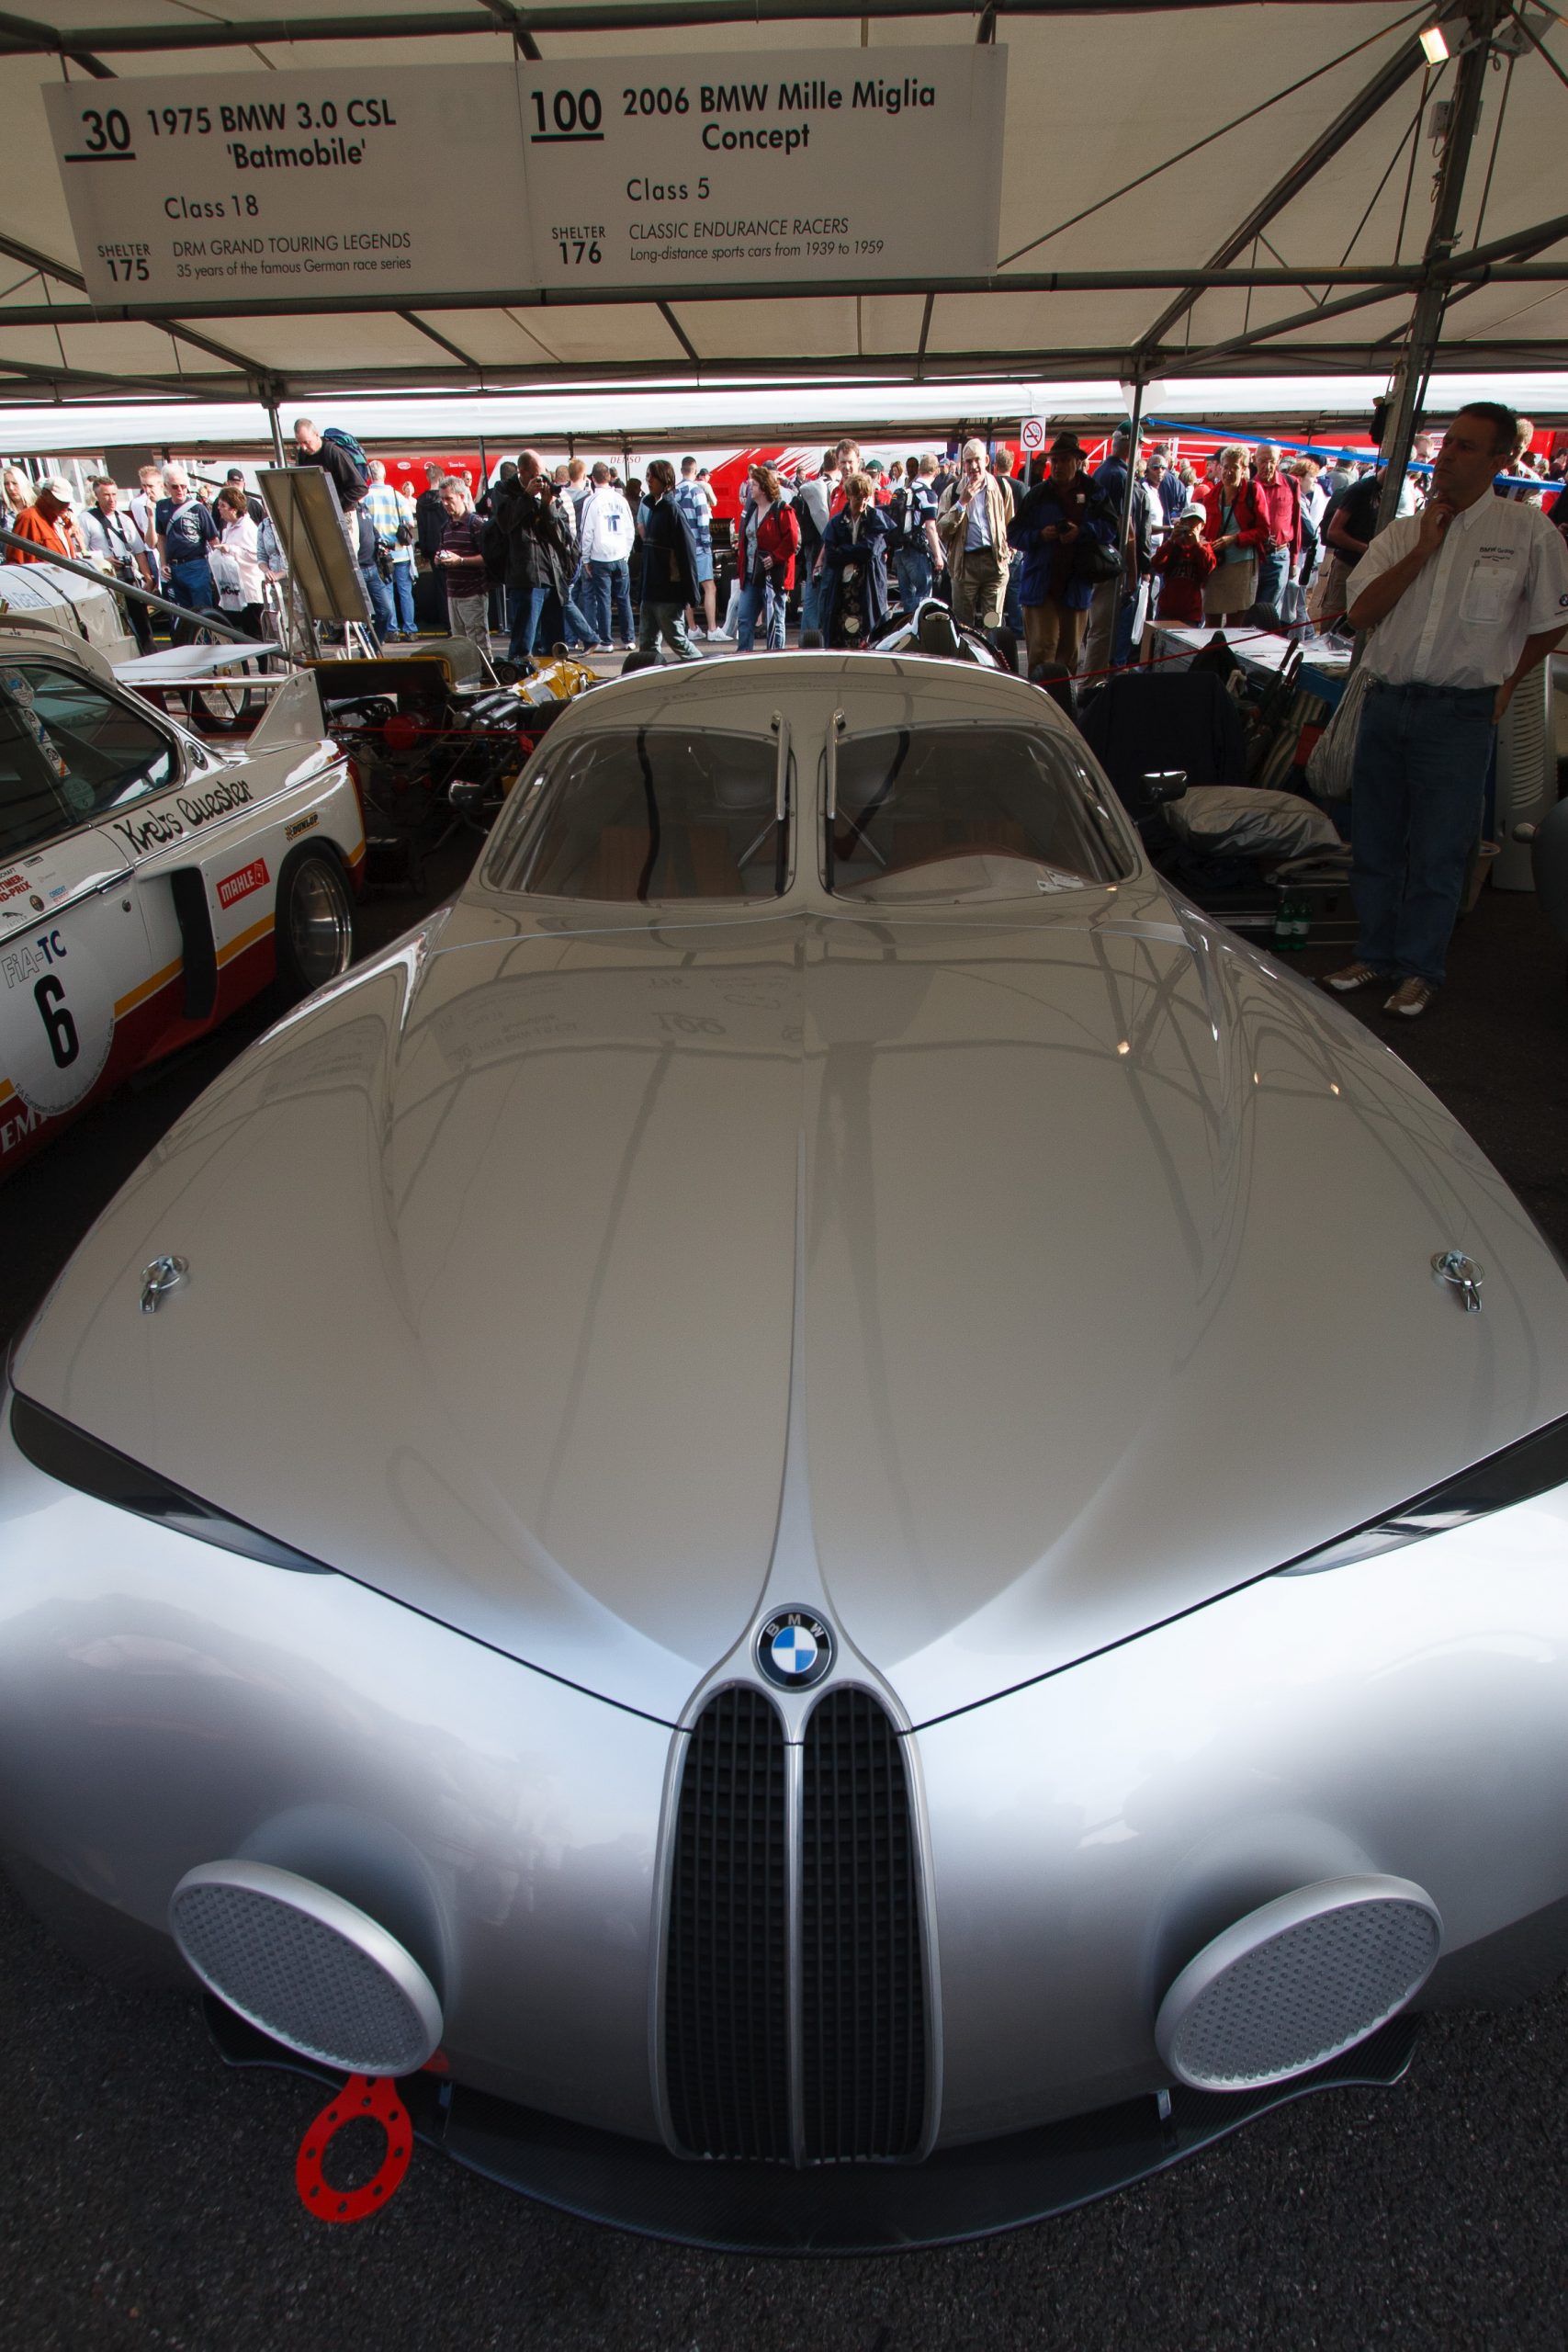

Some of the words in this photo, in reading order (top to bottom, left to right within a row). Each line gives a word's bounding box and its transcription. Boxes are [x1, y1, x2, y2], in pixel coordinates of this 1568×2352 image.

[623, 86, 689, 116] 2006
[700, 85, 768, 112] BMW
[778, 80, 843, 110] Mille
[852, 77, 935, 115] Miglia
[147, 107, 212, 136] 1975
[220, 103, 286, 132] BMW
[297, 101, 338, 130] 3.0
[347, 98, 397, 127] CSL
[531, 88, 603, 132] 100
[82, 108, 131, 152] 30
[702, 123, 810, 155] Concept
[227, 137, 366, 170] 'Batmobile'
[626, 177, 689, 201] Class
[697, 177, 710, 199] 5
[164, 196, 226, 220] Class
[231, 194, 260, 217] 18
[552, 226, 606, 240] SHELTER
[629, 222, 689, 240] CLASSIC
[694, 220, 787, 238] ENDURANCE
[793, 218, 850, 235] RACERS
[97, 243, 152, 257] SHELTER
[173, 241, 207, 257] DRM
[210, 238, 265, 255] GRAND
[268, 235, 339, 254] TOURING
[344, 232, 412, 250] LEGENDS
[558, 242, 602, 265] 176
[630, 244, 708, 264] Long-distance
[712, 244, 745, 262] sports
[748, 246, 772, 258] cars
[774, 242, 801, 256] from
[806, 241, 835, 255] 1939
[838, 242, 851, 254] to
[854, 240, 884, 254] 1959
[107, 258, 150, 282] 175
[177, 264, 191, 277] 35
[195, 265, 223, 279] years
[227, 261, 239, 276] of
[240, 262, 258, 275] the
[261, 260, 301, 274] famous
[304, 258, 350, 273] German
[353, 261, 378, 271] race
[380, 255, 412, 270] series
[292, 814, 319, 835] DUNLOP
[220, 869, 255, 903] MAHLE
[34, 974, 80, 1069] 6
[766, 1614, 825, 1638] BMW
